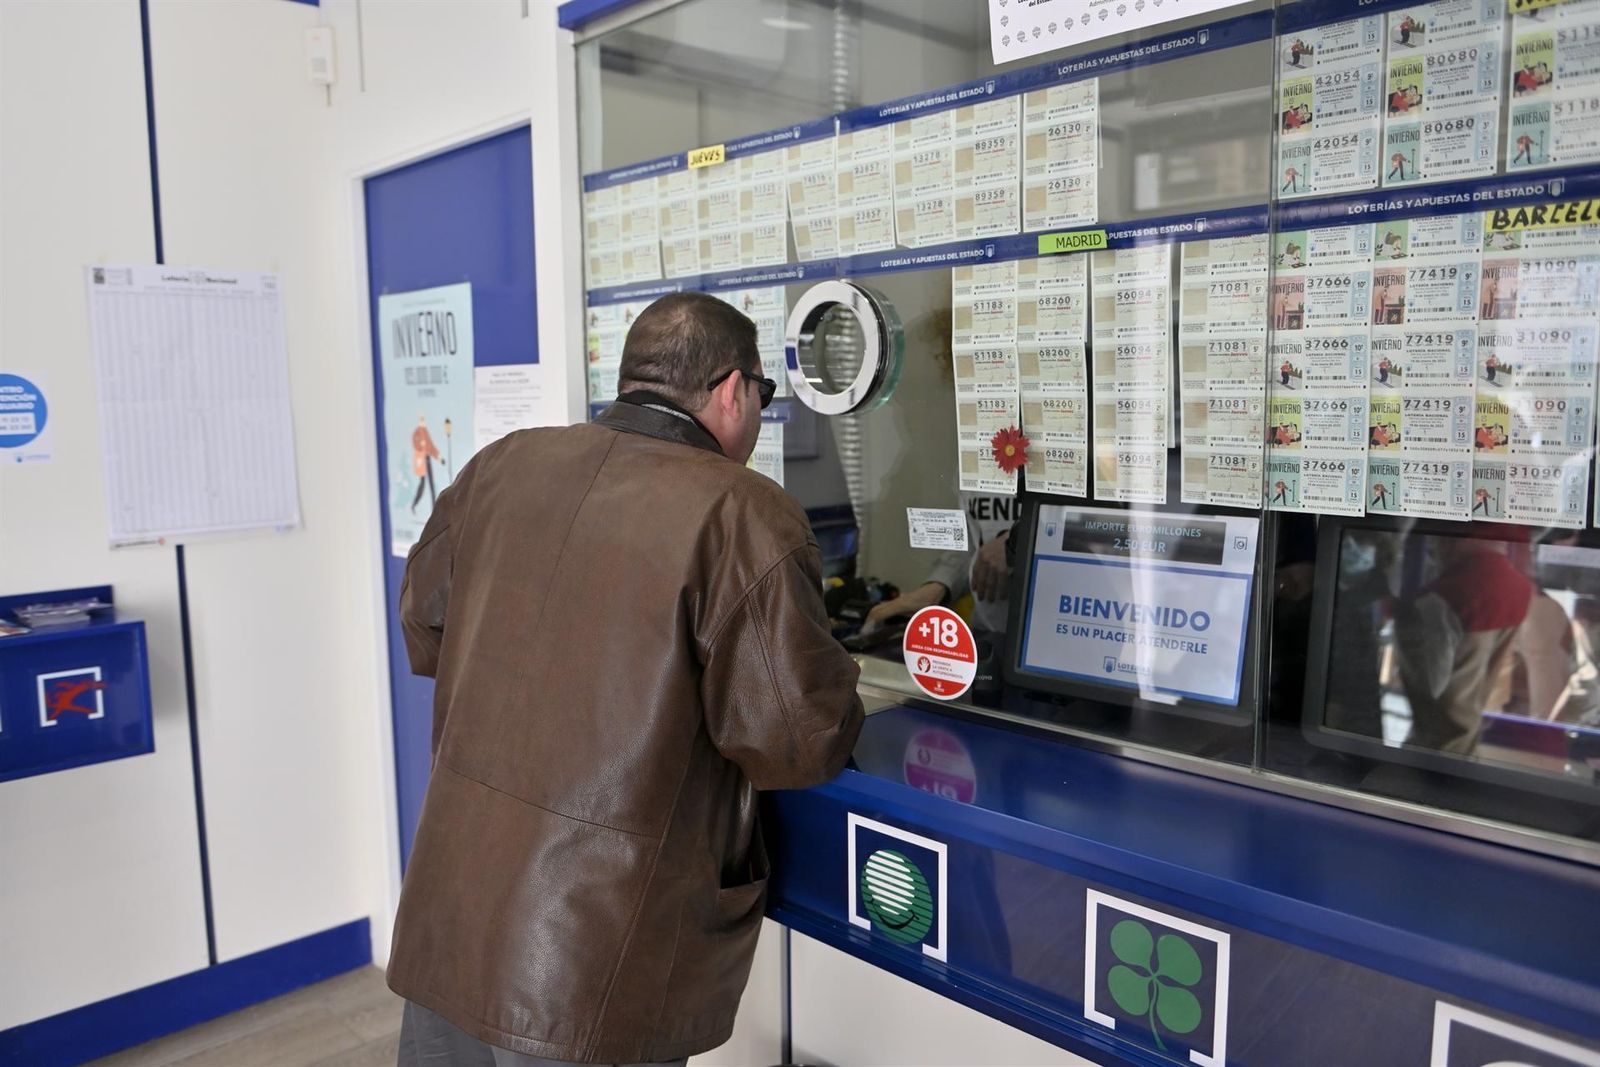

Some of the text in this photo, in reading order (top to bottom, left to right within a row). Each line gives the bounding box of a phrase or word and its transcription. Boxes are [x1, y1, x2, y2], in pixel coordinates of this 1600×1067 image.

[1516, 39, 1553, 55] INVIERNO
[1058, 60, 1097, 75] LOTERÍAS
[1104, 49, 1144, 63] APUESTAS
[1145, 45, 1160, 54] DEL
[1162, 36, 1195, 50] ESTADO
[1427, 48, 1477, 67] 80680
[1390, 63, 1422, 78] INVIERNO
[1316, 70, 1360, 86] 42054
[1283, 83, 1312, 97] INVIERNO
[880, 104, 910, 117] LOTERÍAS
[914, 97, 945, 109] APUESTAS
[946, 93, 958, 101] DEL
[959, 87, 984, 98] ESTADO
[1513, 110, 1549, 126] INVIERNO
[1048, 123, 1081, 136] 26130
[1424, 118, 1474, 134] 80680
[1314, 135, 1358, 149] 42054
[1388, 130, 1420, 144] INVIERNO
[975, 138, 1005, 150] 89359
[691, 151, 720, 166] JUEVES
[1282, 146, 1311, 160] INVIERNO
[1049, 178, 1081, 189] 26130
[975, 190, 1005, 201] 89359
[1348, 199, 1403, 215] LOTERÍAS
[1415, 193, 1470, 207] APUESTAS
[1473, 190, 1494, 201] DEL
[1497, 185, 1544, 199] ESTADO
[1144, 227, 1158, 235] DEL
[1160, 223, 1192, 234] ESTADO
[1056, 234, 1102, 248] MADRID
[881, 256, 910, 268] LOTERÍAS
[915, 253, 945, 264] APUESTAS
[946, 252, 958, 260] DEL
[960, 249, 984, 258] ESTADO
[1482, 266, 1517, 279] INVIERNO
[1522, 260, 1577, 273] 31090
[1409, 268, 1457, 280] 77419
[1307, 276, 1351, 288] 37666
[1374, 274, 1405, 287] INVIERNO
[1210, 282, 1248, 293] 71081
[974, 301, 1003, 311] 51183
[1039, 296, 1071, 306] 68260
[393, 311, 457, 359] INVIERNO
[1406, 334, 1454, 344] 77419
[1478, 335, 1512, 347] INVIERNO
[1517, 331, 1571, 342] 31090
[1209, 342, 1246, 351] 71081
[1305, 339, 1348, 349] 37666
[1371, 339, 1402, 350] INVIERNO
[974, 351, 1003, 360] 51183
[1039, 349, 1070, 357] 68260
[978, 400, 1006, 408] 51183
[1043, 400, 1073, 408] 68260
[1209, 400, 1247, 408] 71081
[1304, 401, 1347, 410] 37666
[1370, 403, 1400, 414] INVIERNO
[1404, 400, 1451, 410] 77419
[1046, 450, 1075, 459] 68260
[1210, 456, 1247, 465] 71081
[1303, 460, 1345, 470] 37666
[1370, 465, 1400, 476] INVIERNO
[1403, 462, 1449, 474] 77419
[1472, 467, 1505, 480] INVIERNO
[1509, 466, 1562, 478] 31090
[1085, 521, 1125, 532] IMPORTE
[1113, 538, 1166, 553] 2,50 EUR
[1059, 594, 1210, 632] BIENVENIDO
[918, 617, 958, 648] +18
[1056, 624, 1208, 654] ES UN PLACER ATENDERLE
